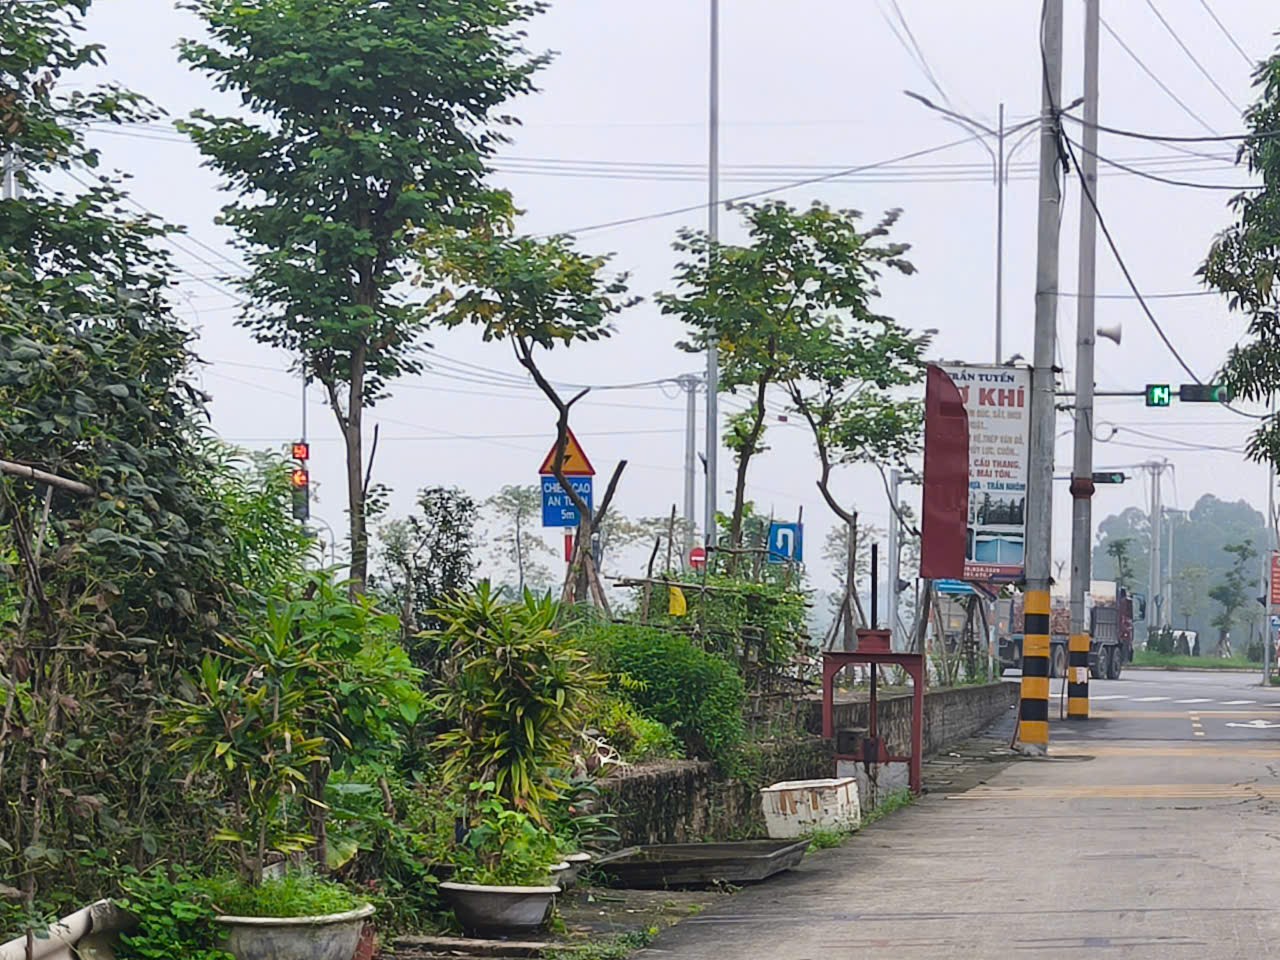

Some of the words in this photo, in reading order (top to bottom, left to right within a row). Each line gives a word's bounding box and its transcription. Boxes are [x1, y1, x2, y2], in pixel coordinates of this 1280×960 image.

[979, 385, 1024, 408] KHÍ
[572, 482, 591, 493] CAO
[548, 495, 561, 506] AN
[561, 509, 575, 520] 5m
